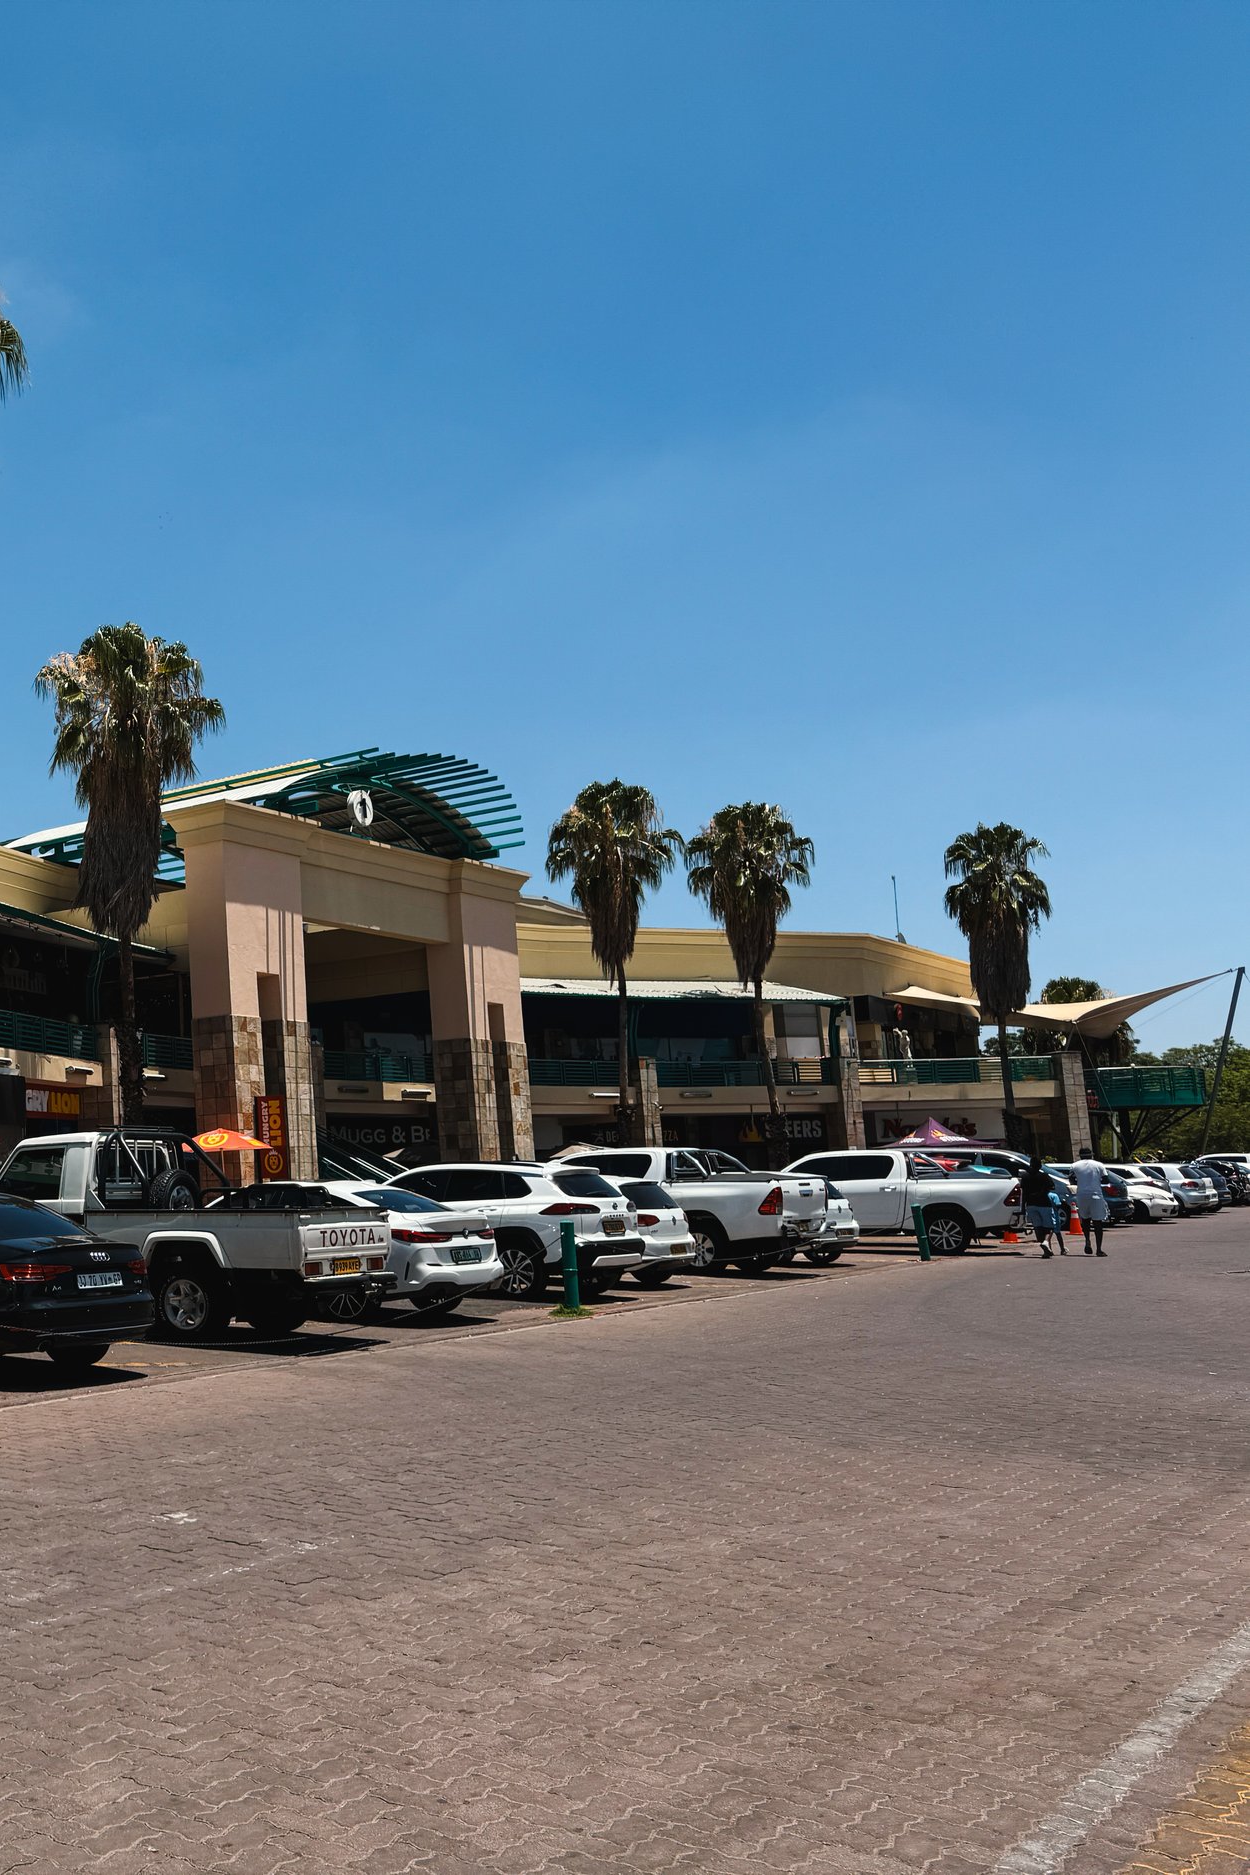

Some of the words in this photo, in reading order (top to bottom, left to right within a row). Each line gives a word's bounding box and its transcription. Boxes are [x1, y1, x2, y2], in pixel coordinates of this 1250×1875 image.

[25, 1089, 50, 1112] GRY
[51, 1091, 80, 1115] LION
[268, 1099, 282, 1147] LION
[764, 1119, 822, 1139] SEERS
[330, 1125, 387, 1144] MUGG
[391, 1125, 406, 1144] &
[663, 1130, 679, 1142] ZZA
[320, 1228, 376, 1247] TOYOTA
